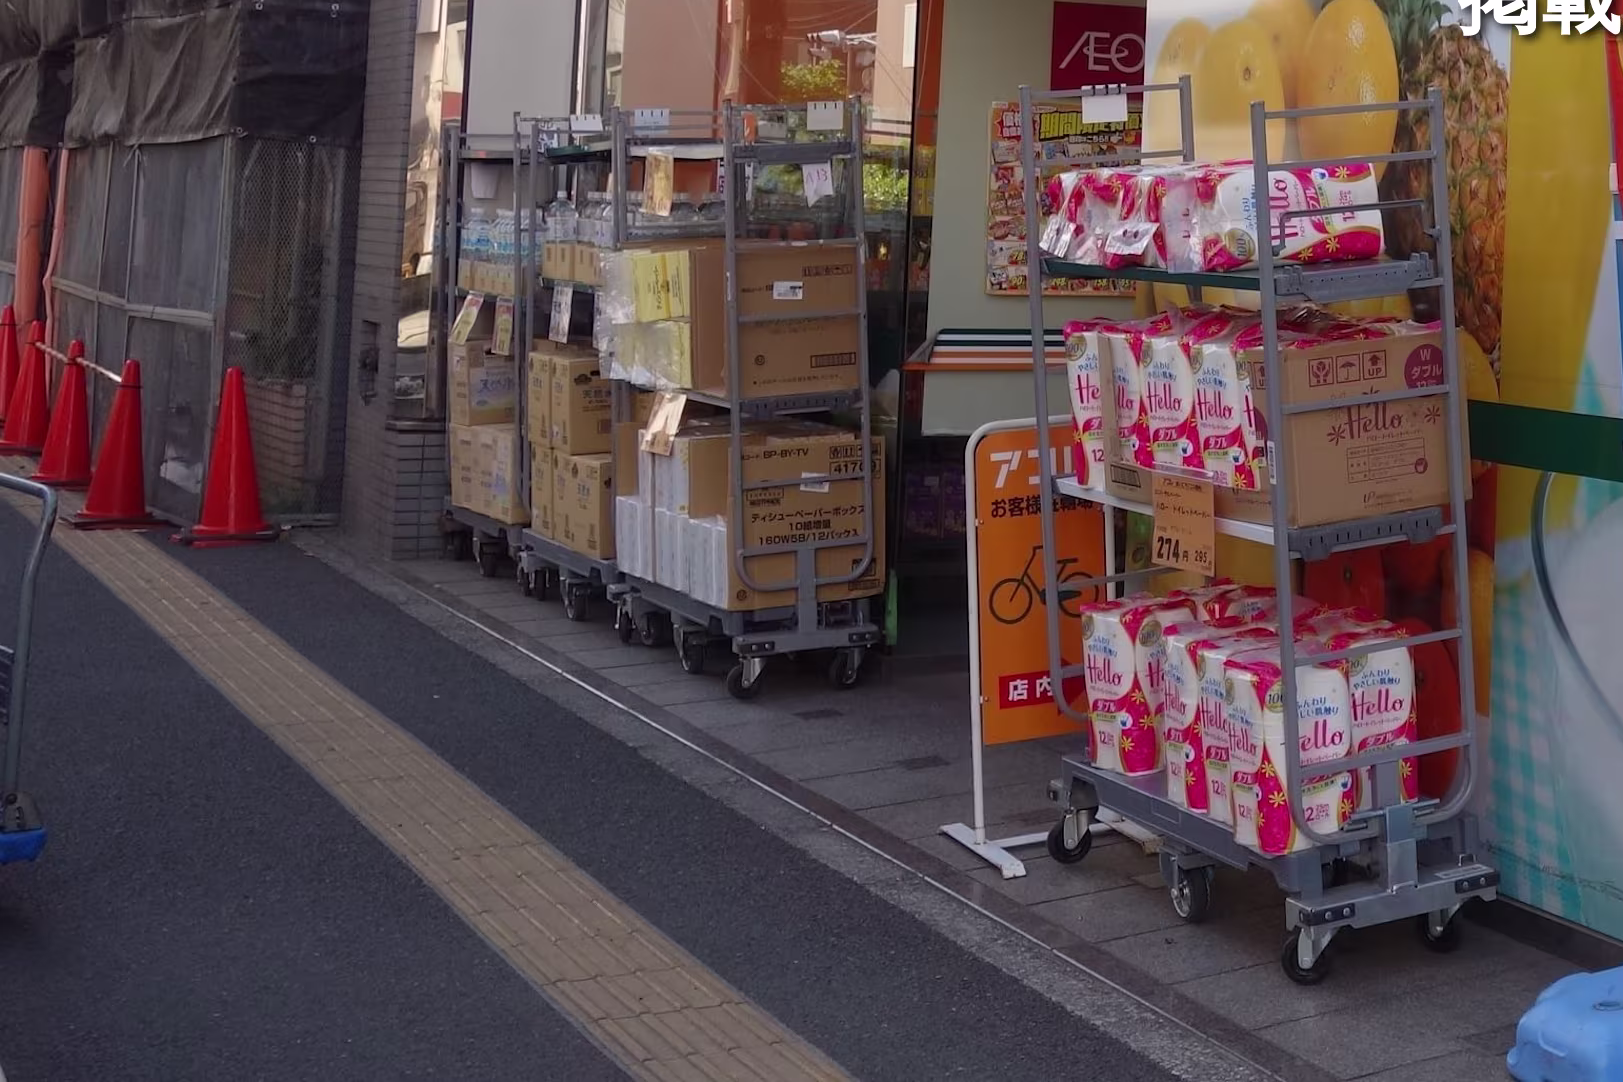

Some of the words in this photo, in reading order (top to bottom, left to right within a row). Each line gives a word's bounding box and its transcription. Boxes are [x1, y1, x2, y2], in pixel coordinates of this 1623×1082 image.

[1058, 31, 1145, 73] AEO
[1420, 348, 1431, 361] W
[1367, 367, 1382, 377] UP
[1147, 381, 1183, 413] Hello
[1197, 388, 1234, 420] Hello
[1345, 402, 1403, 439] Hello
[1157, 536, 1181, 564] 274
[1087, 654, 1123, 686] Hello
[1351, 688, 1405, 722] Hello
[1228, 722, 1257, 756] Hello
[1299, 719, 1344, 752] ello
